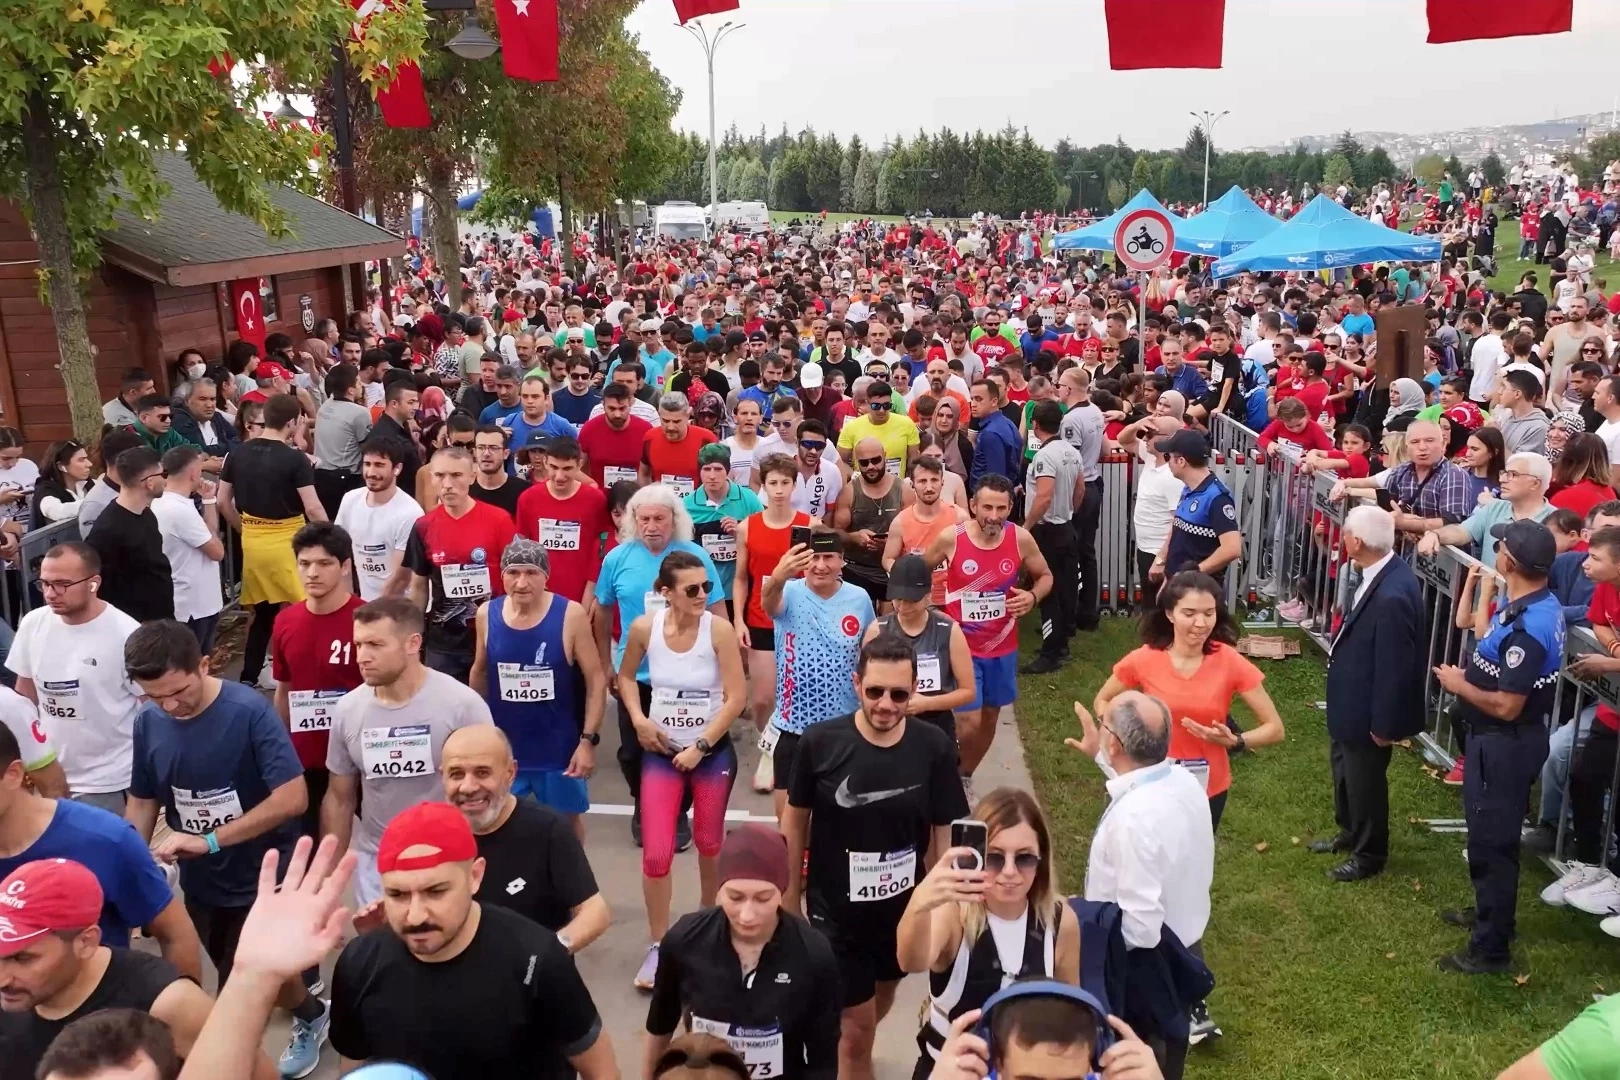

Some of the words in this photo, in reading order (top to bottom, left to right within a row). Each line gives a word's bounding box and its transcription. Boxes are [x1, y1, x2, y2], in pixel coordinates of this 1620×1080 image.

[543, 539, 575, 548] 41940
[709, 550, 738, 561] 41362
[451, 584, 484, 596] 41155
[968, 609, 1000, 620] 41710
[328, 639, 351, 665] 21
[505, 688, 549, 700] 41405
[299, 716, 332, 729] 4141
[662, 716, 705, 728] 41560
[372, 760, 426, 775] 41042
[857, 876, 909, 898] 41600
